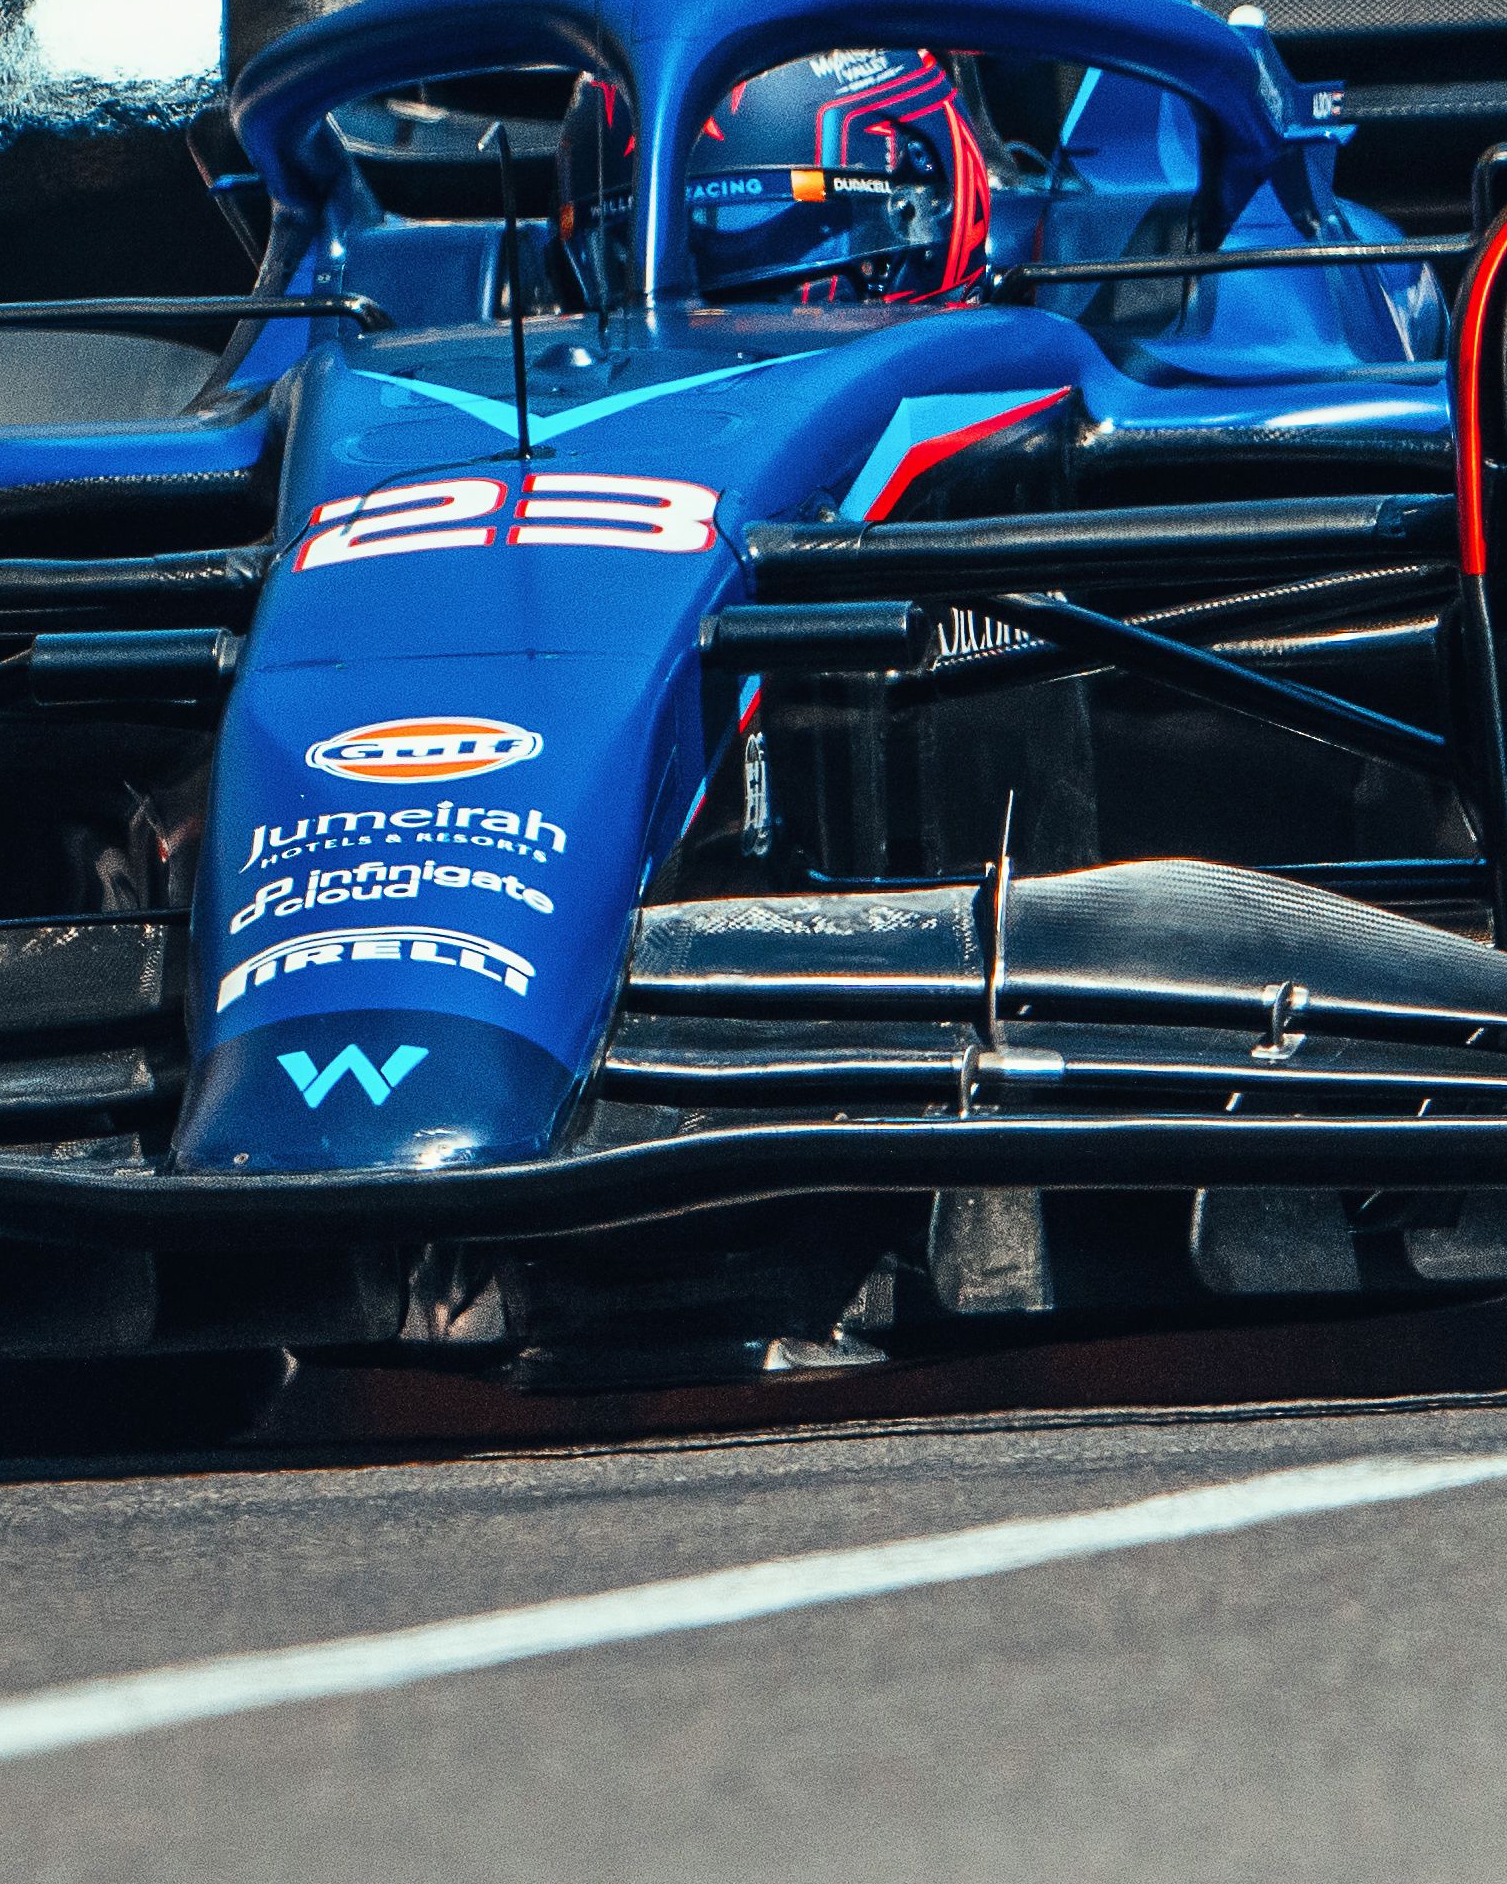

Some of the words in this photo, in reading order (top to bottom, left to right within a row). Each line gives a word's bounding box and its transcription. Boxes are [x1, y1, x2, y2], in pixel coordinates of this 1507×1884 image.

[833, 176, 893, 194] DURACELL
[292, 473, 720, 572] 23
[238, 800, 567, 875] Jumeirah
[260, 834, 373, 869] HOTELS
[384, 833, 403, 844] &
[415, 832, 548, 864] RESORTS
[273, 877, 422, 917] cloud
[308, 859, 555, 915] infinigate
[216, 925, 537, 1014] PIRELLI
